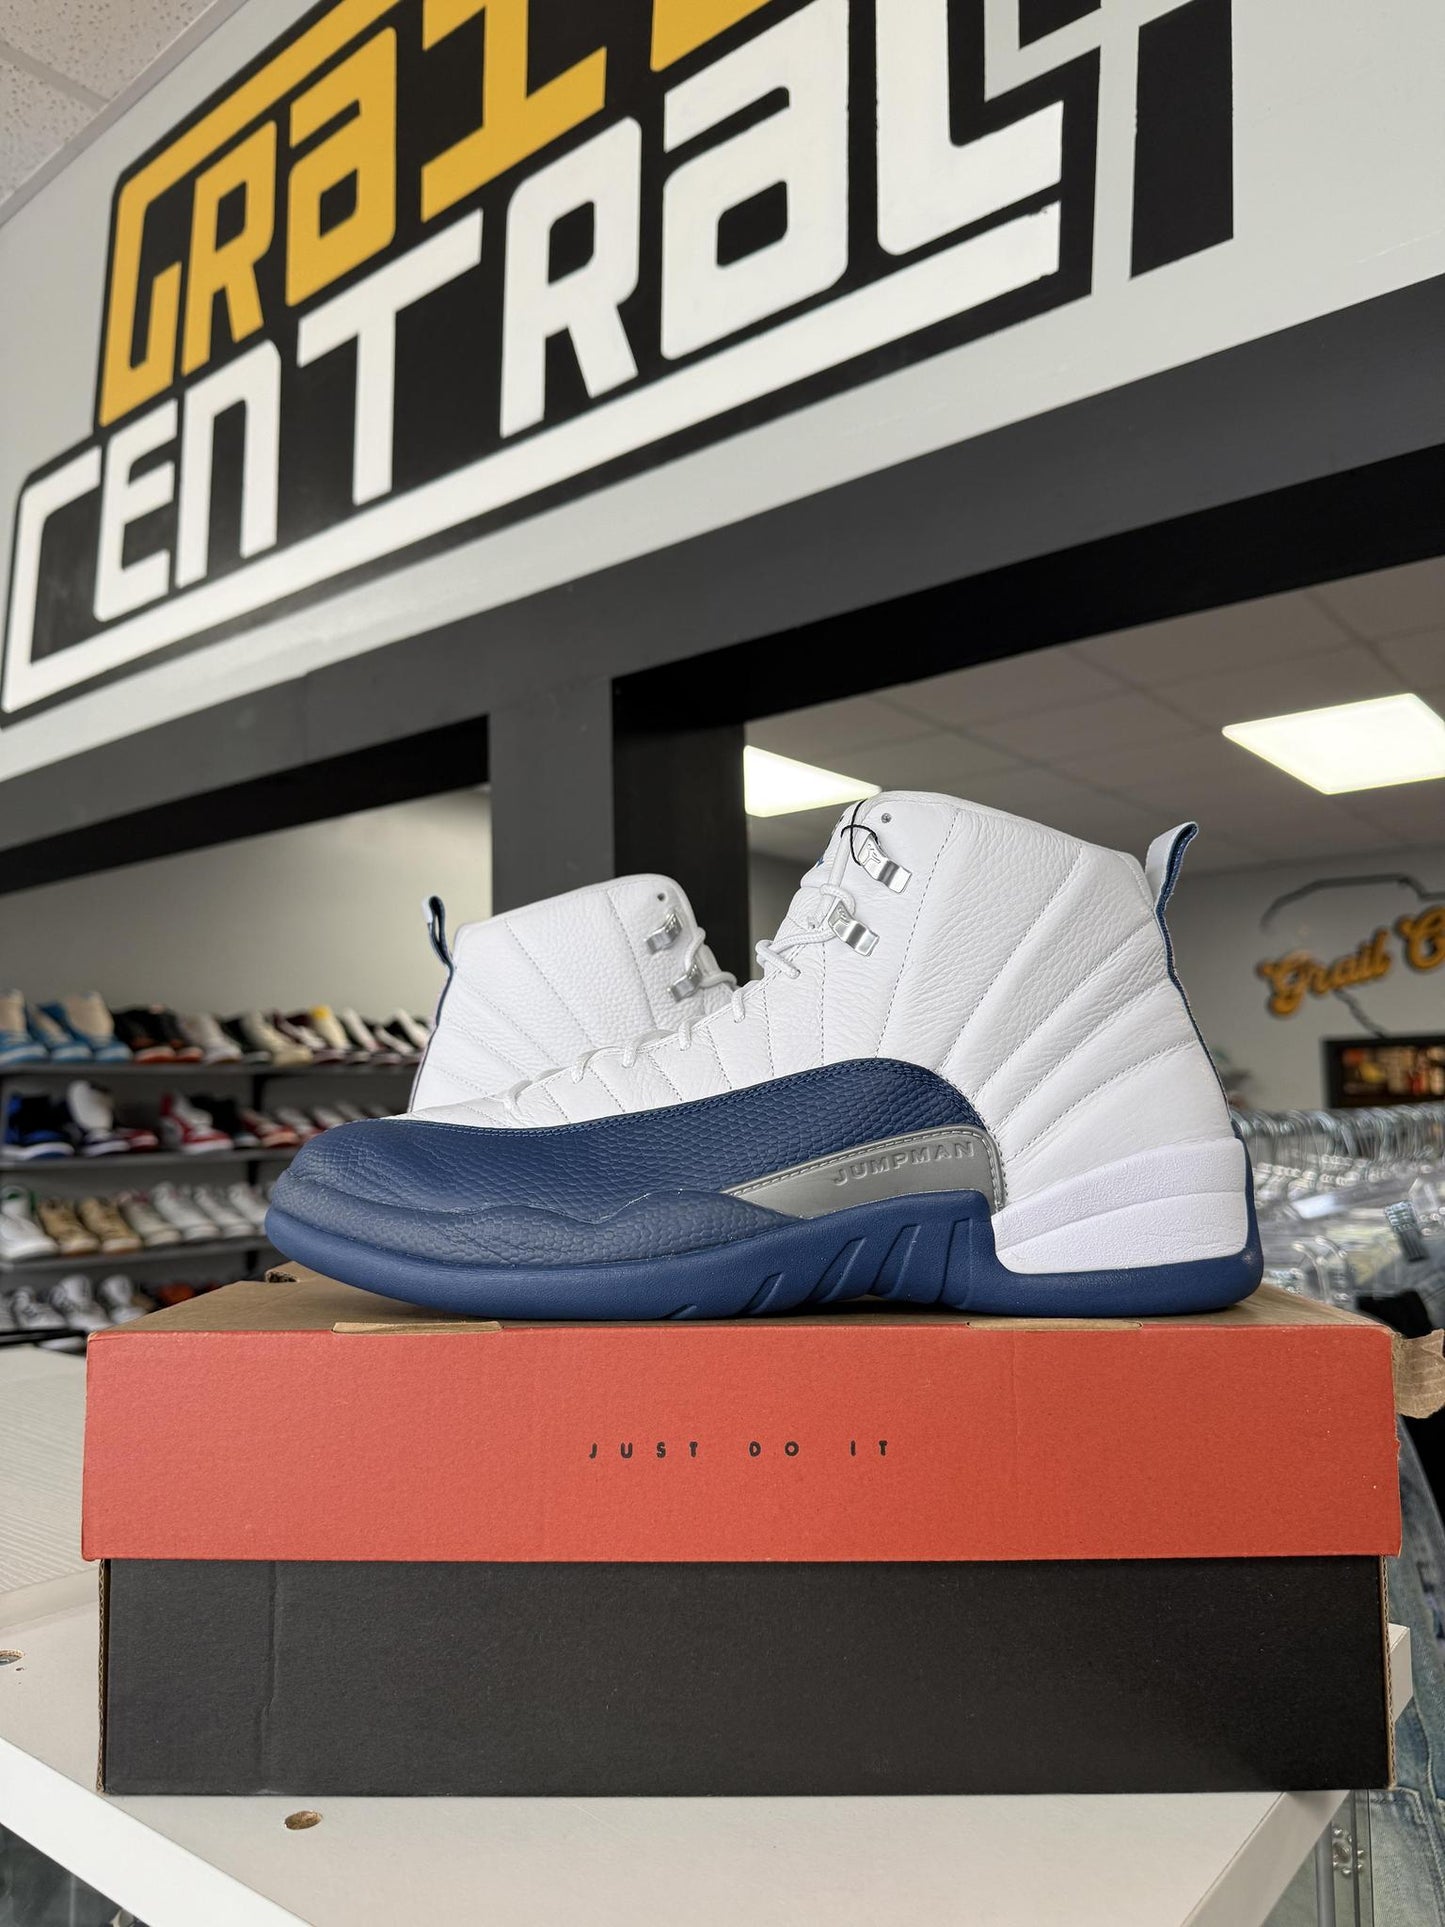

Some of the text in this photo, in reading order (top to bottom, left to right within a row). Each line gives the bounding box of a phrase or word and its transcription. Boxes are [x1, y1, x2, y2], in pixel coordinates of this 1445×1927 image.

[832, 1141, 976, 1186] JUMPMAN
[589, 1440, 888, 1459] JUST DO IT
